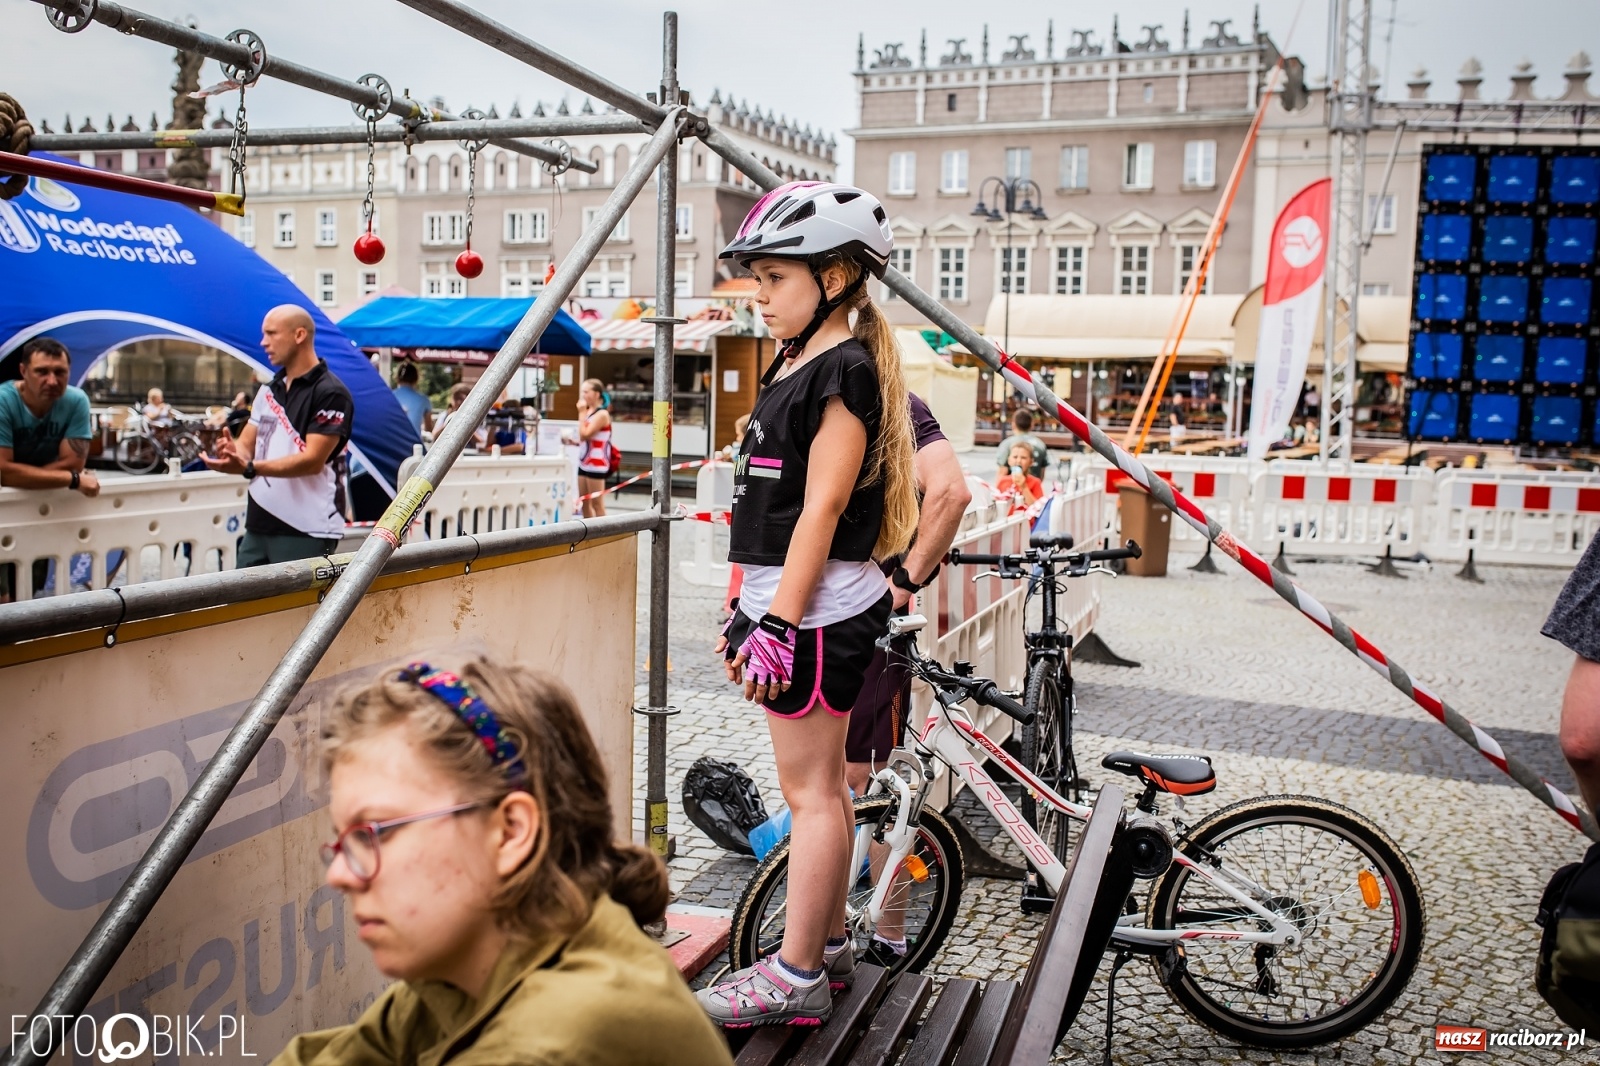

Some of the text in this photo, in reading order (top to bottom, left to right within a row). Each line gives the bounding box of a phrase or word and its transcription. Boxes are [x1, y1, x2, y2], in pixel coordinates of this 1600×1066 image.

[45, 232, 197, 265] Raciborskie
[976, 736, 1009, 763] REPLICA
[959, 761, 1056, 867] KROSS
